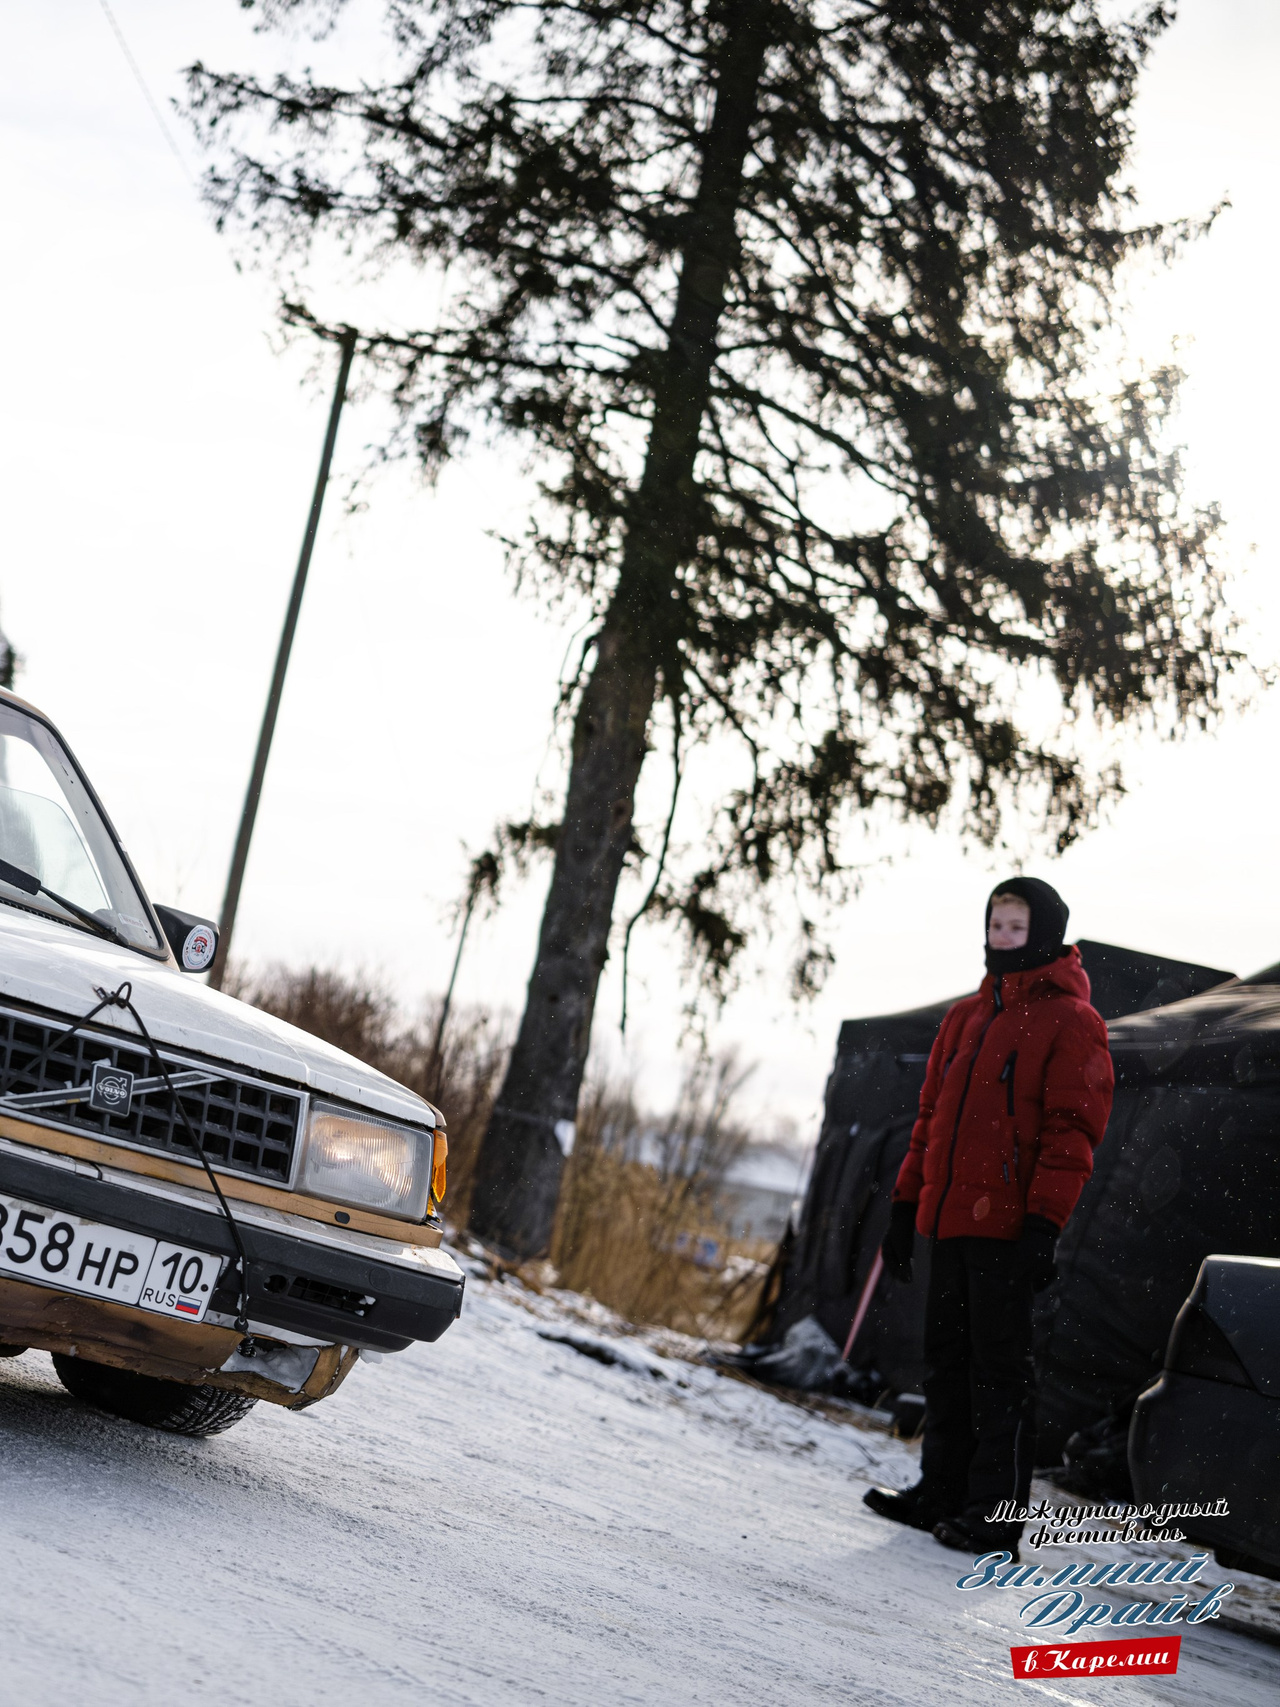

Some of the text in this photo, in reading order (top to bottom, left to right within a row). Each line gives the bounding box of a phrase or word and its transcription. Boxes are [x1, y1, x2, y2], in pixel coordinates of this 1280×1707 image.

[98, 1084, 126, 1096] VOLVO
[161, 1251, 203, 1294] 10
[142, 1287, 177, 1308] RUS
